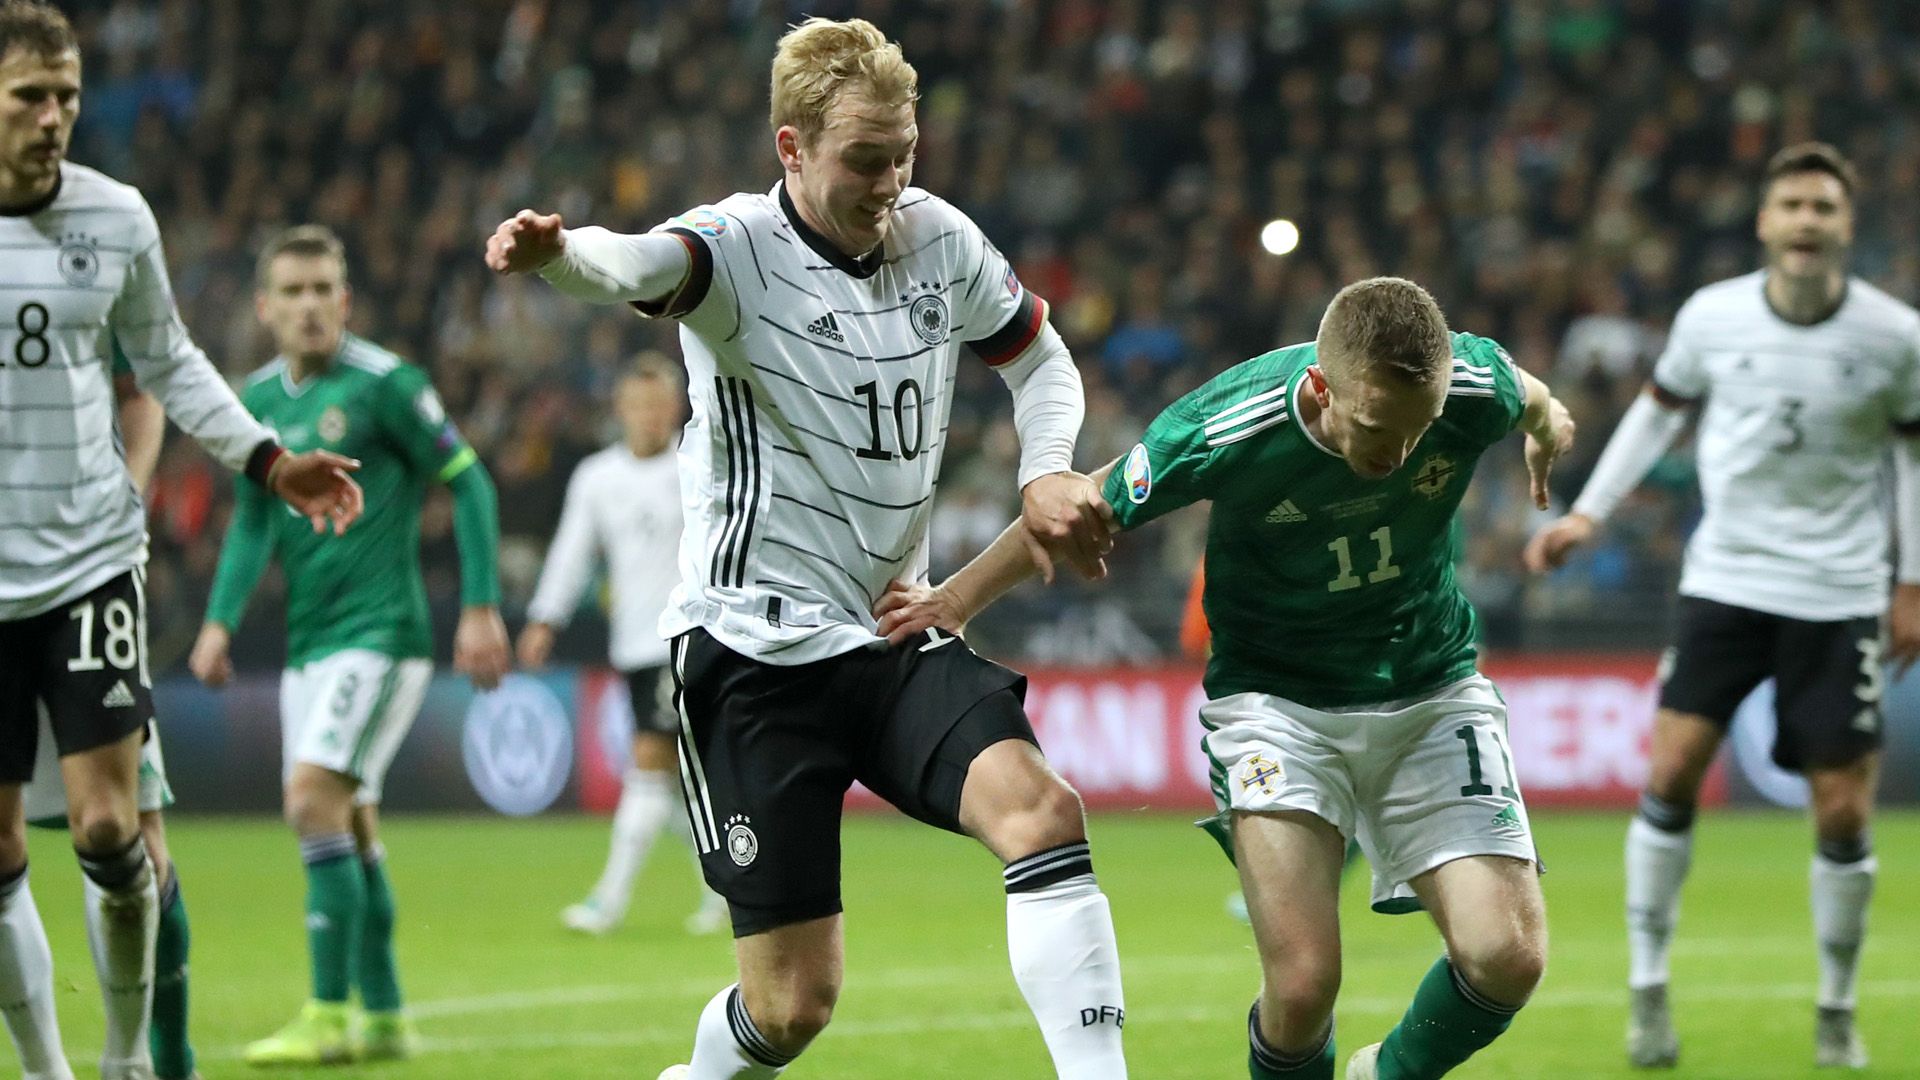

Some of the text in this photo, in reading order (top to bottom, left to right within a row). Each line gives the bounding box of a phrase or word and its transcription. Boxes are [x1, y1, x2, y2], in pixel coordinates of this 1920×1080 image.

[0, 302, 50, 368] 8
[808, 324, 844, 342] adidas
[854, 378, 923, 461] 10
[1265, 513, 1308, 523] adidas
[1327, 526, 1400, 592] 11
[67, 598, 137, 672] 18
[1854, 638, 1885, 702] 3
